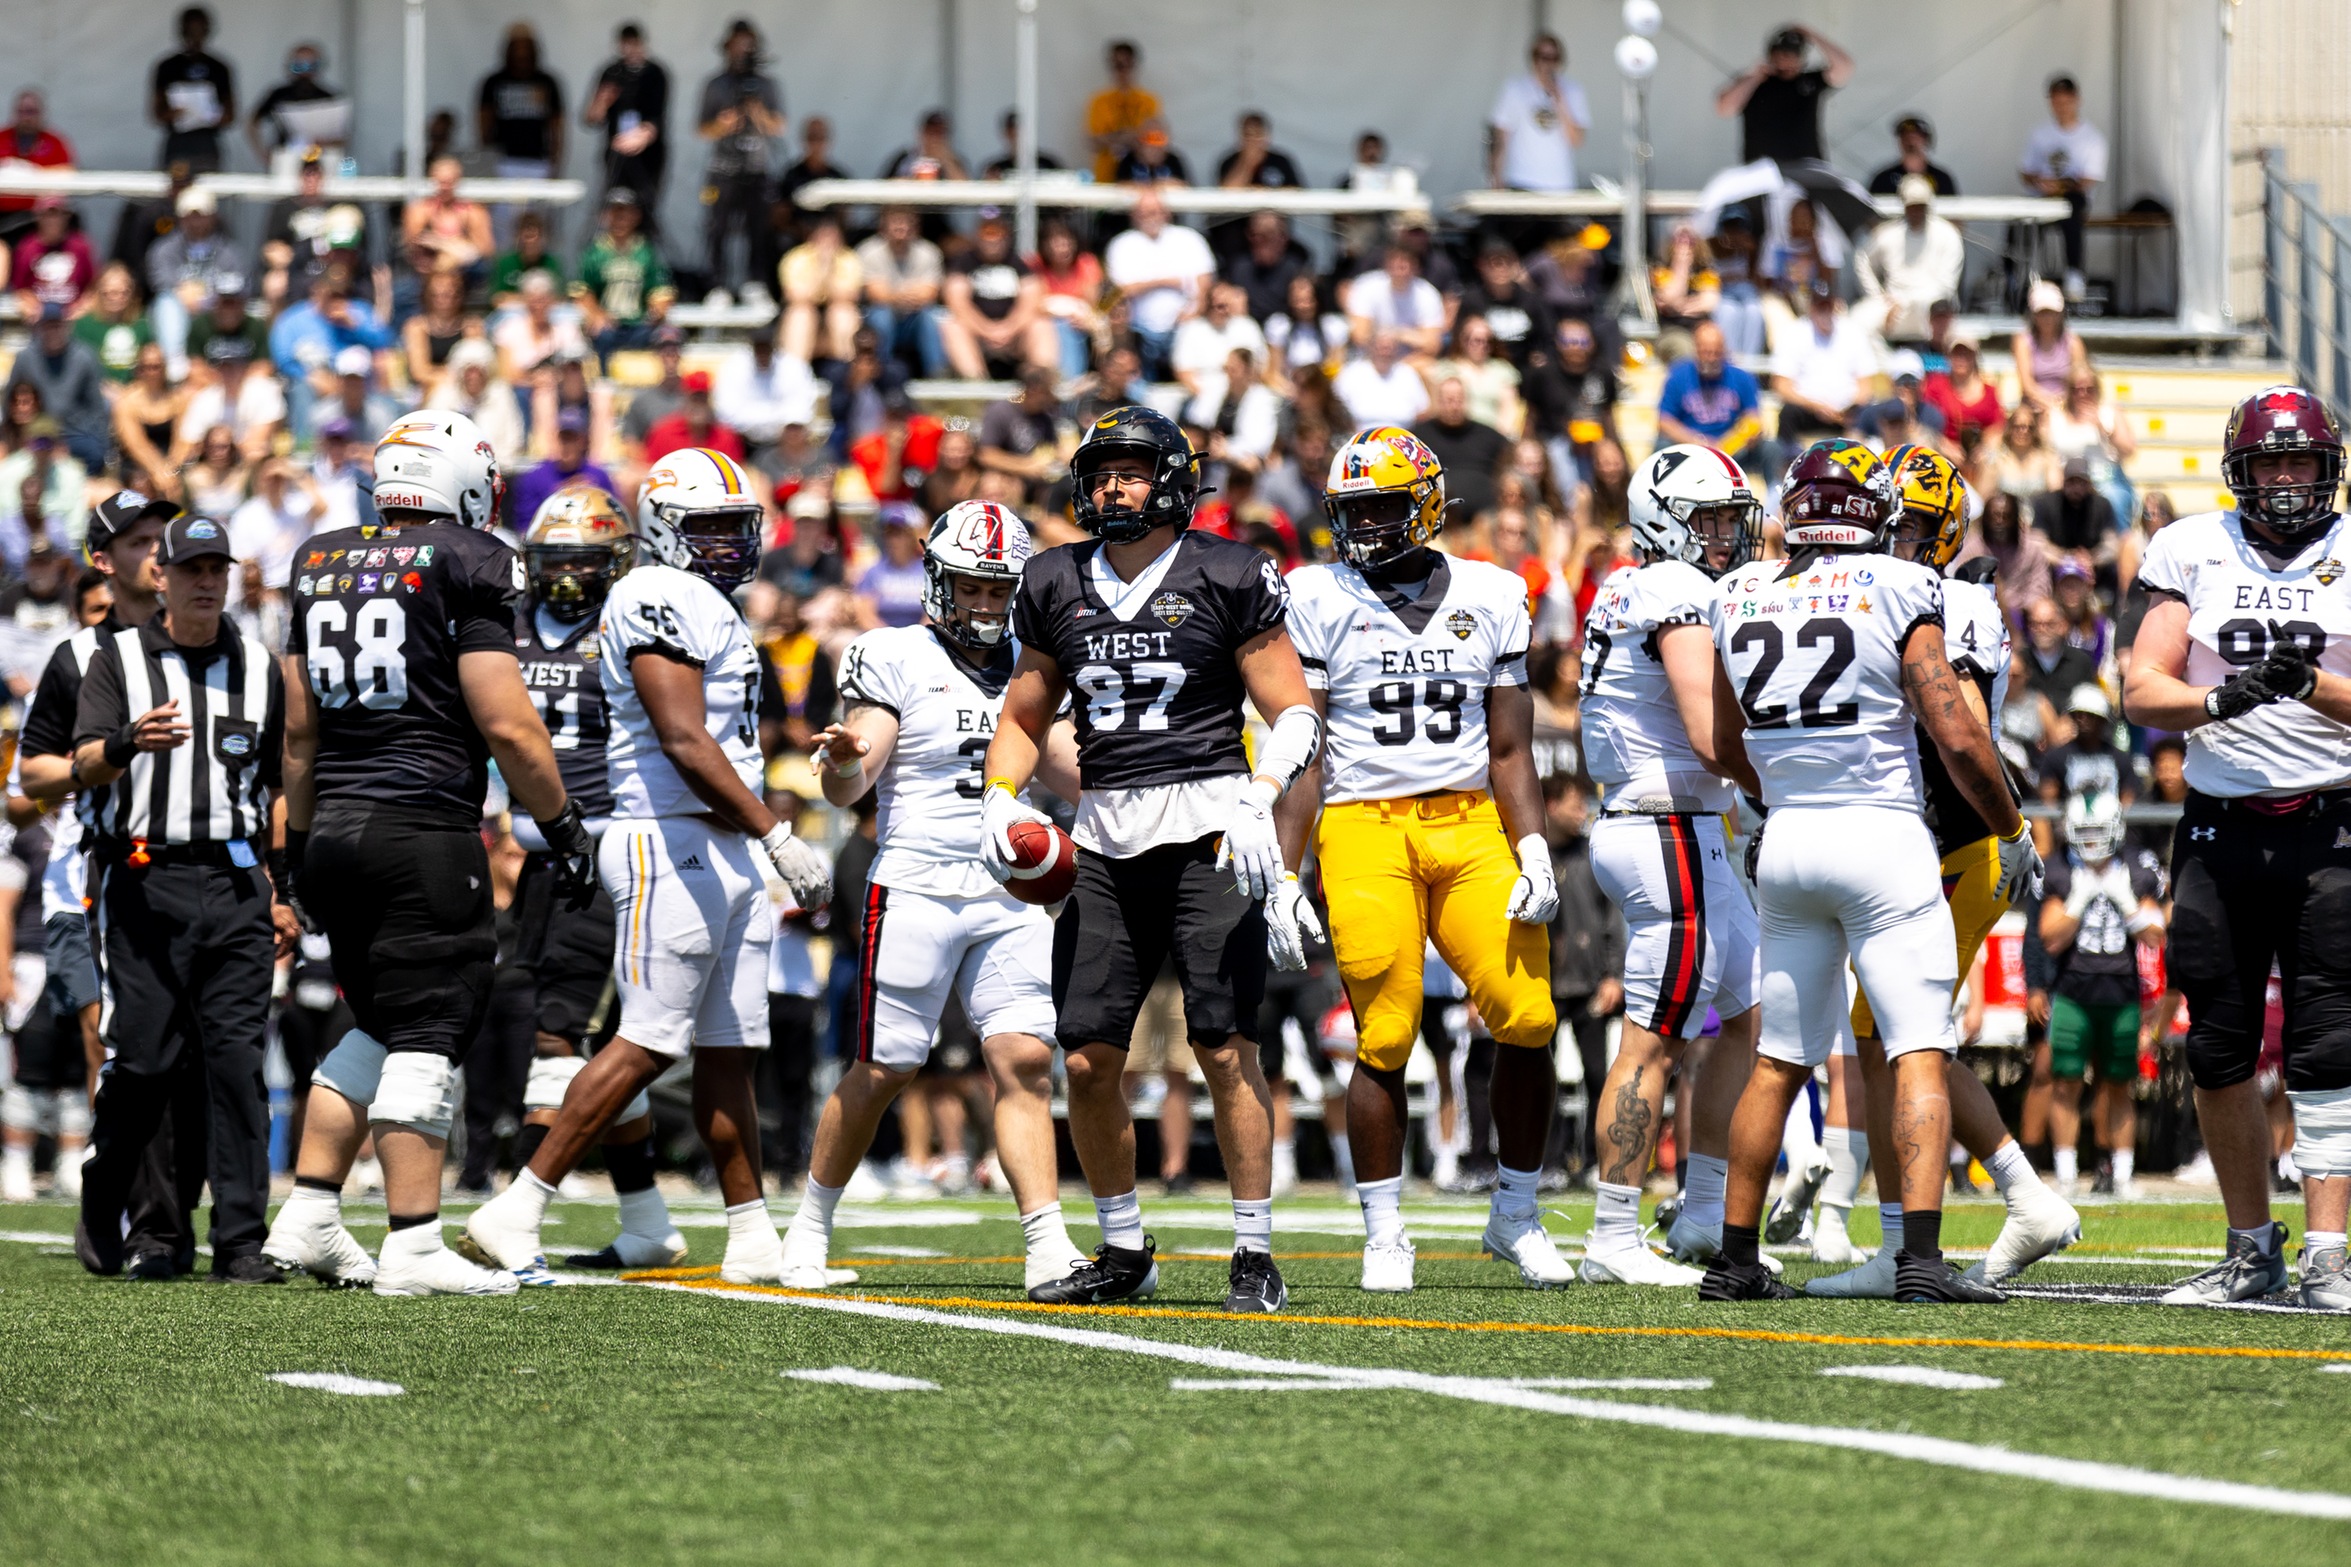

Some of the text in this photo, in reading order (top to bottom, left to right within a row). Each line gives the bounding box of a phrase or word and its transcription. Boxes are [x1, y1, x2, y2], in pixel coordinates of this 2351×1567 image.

[1343, 478, 1370, 489] Riddell
[374, 494, 423, 507] Riddell
[1798, 530, 1857, 542] Riddell
[980, 563, 1005, 571] RAVENS
[2234, 585, 2314, 612] EAST
[640, 604, 679, 637] 55
[1085, 632, 1171, 660] WEST
[1960, 620, 1978, 652] 4
[306, 598, 409, 710] 68
[1381, 649, 1454, 674] EAST
[1731, 618, 1859, 729] 22
[1076, 662, 1187, 731] 87
